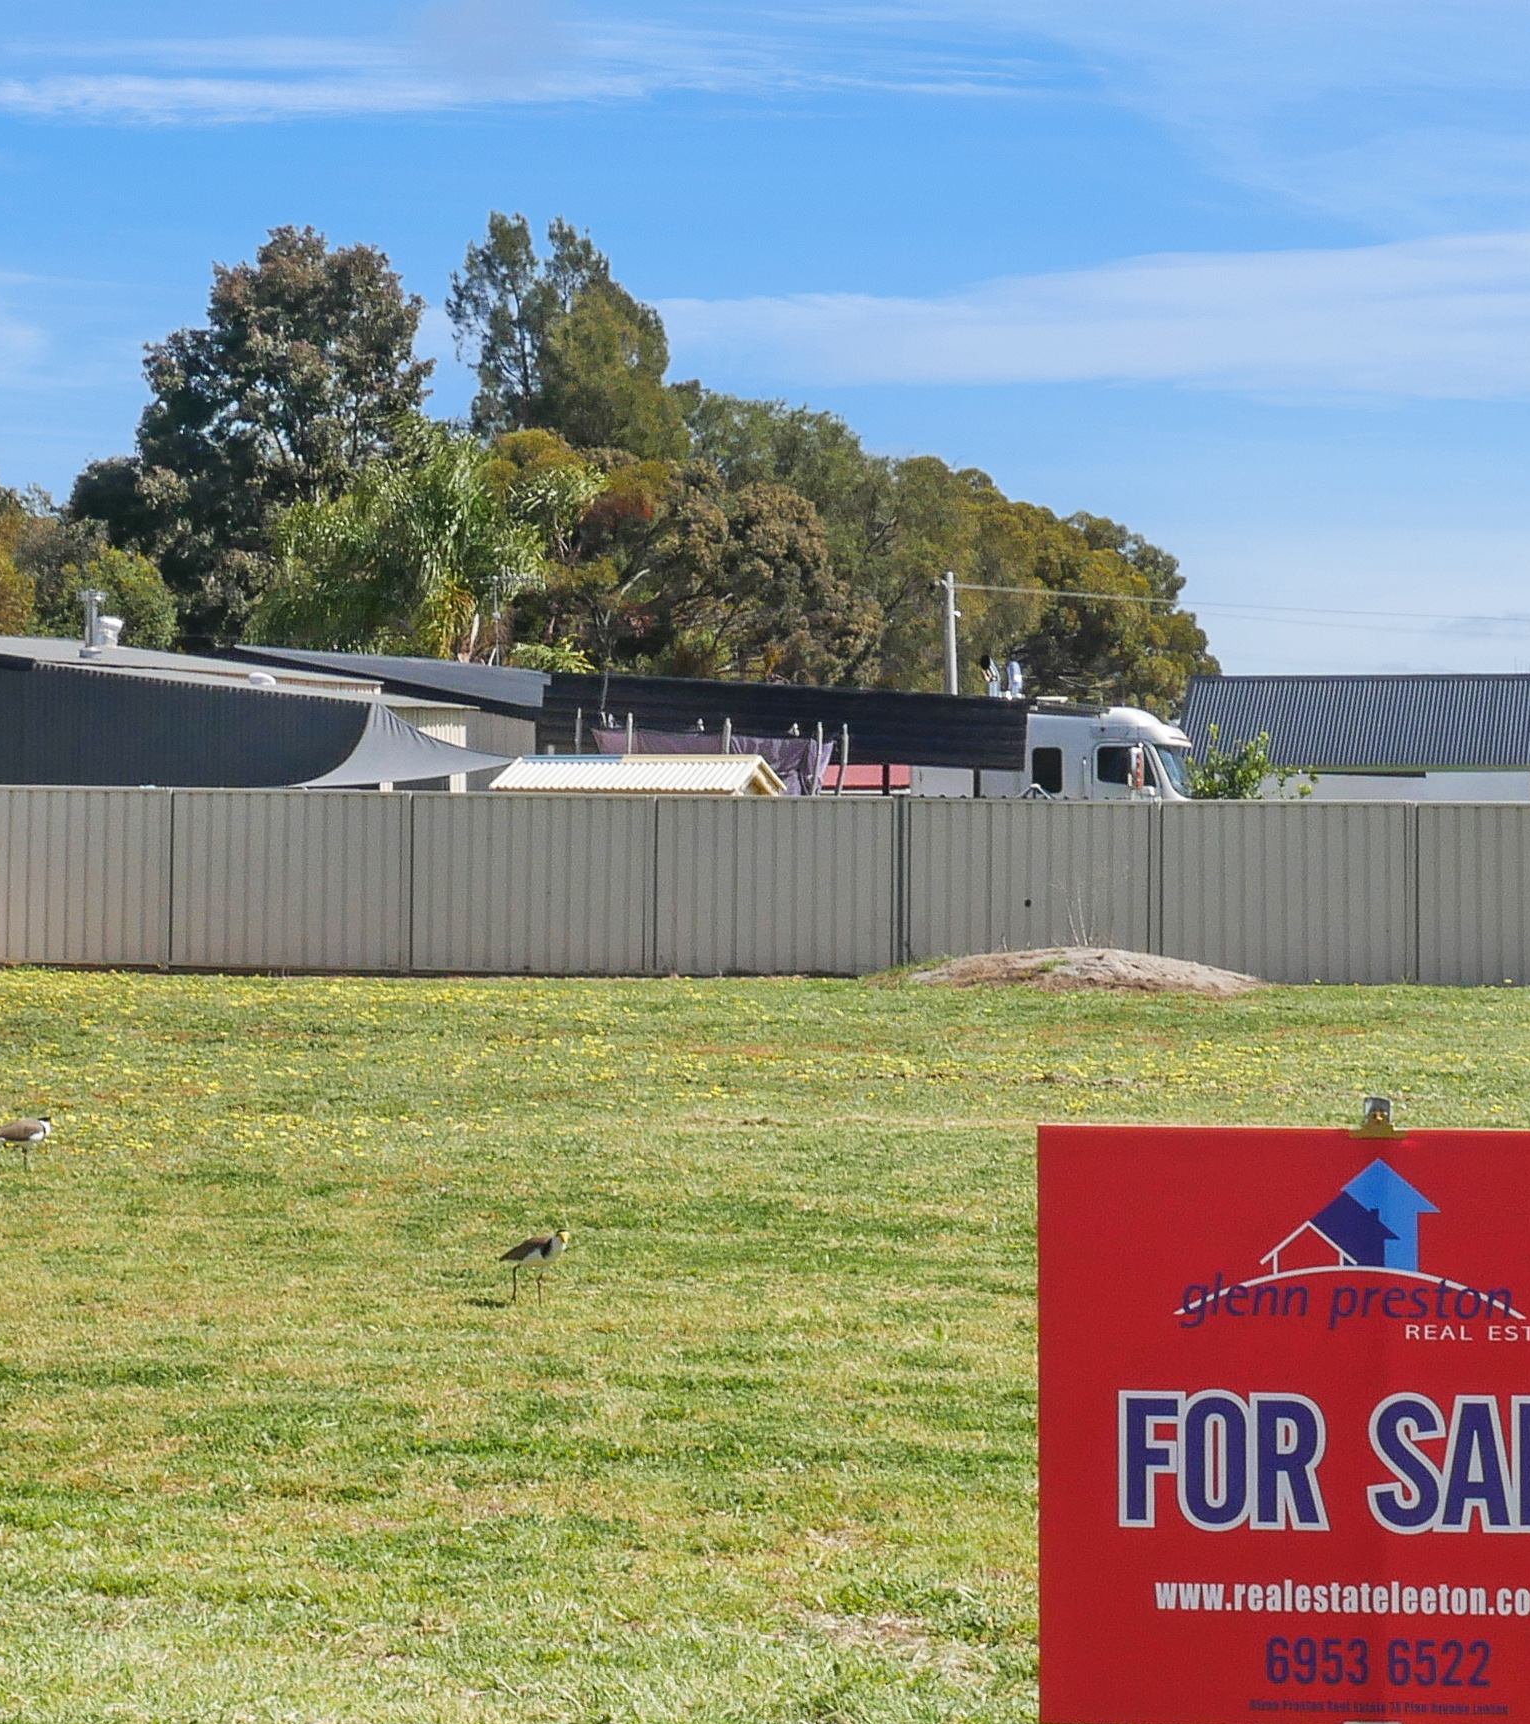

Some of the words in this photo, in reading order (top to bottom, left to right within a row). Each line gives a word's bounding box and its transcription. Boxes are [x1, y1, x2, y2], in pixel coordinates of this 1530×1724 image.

[1180, 1272, 1309, 1329] glenn
[1328, 1278, 1513, 1330] preston
[1405, 1324, 1473, 1341] REAL
[1118, 1388, 1330, 1531] FOR
[1266, 1636, 1369, 1685] 6953
[1387, 1639, 1492, 1687] 6522
